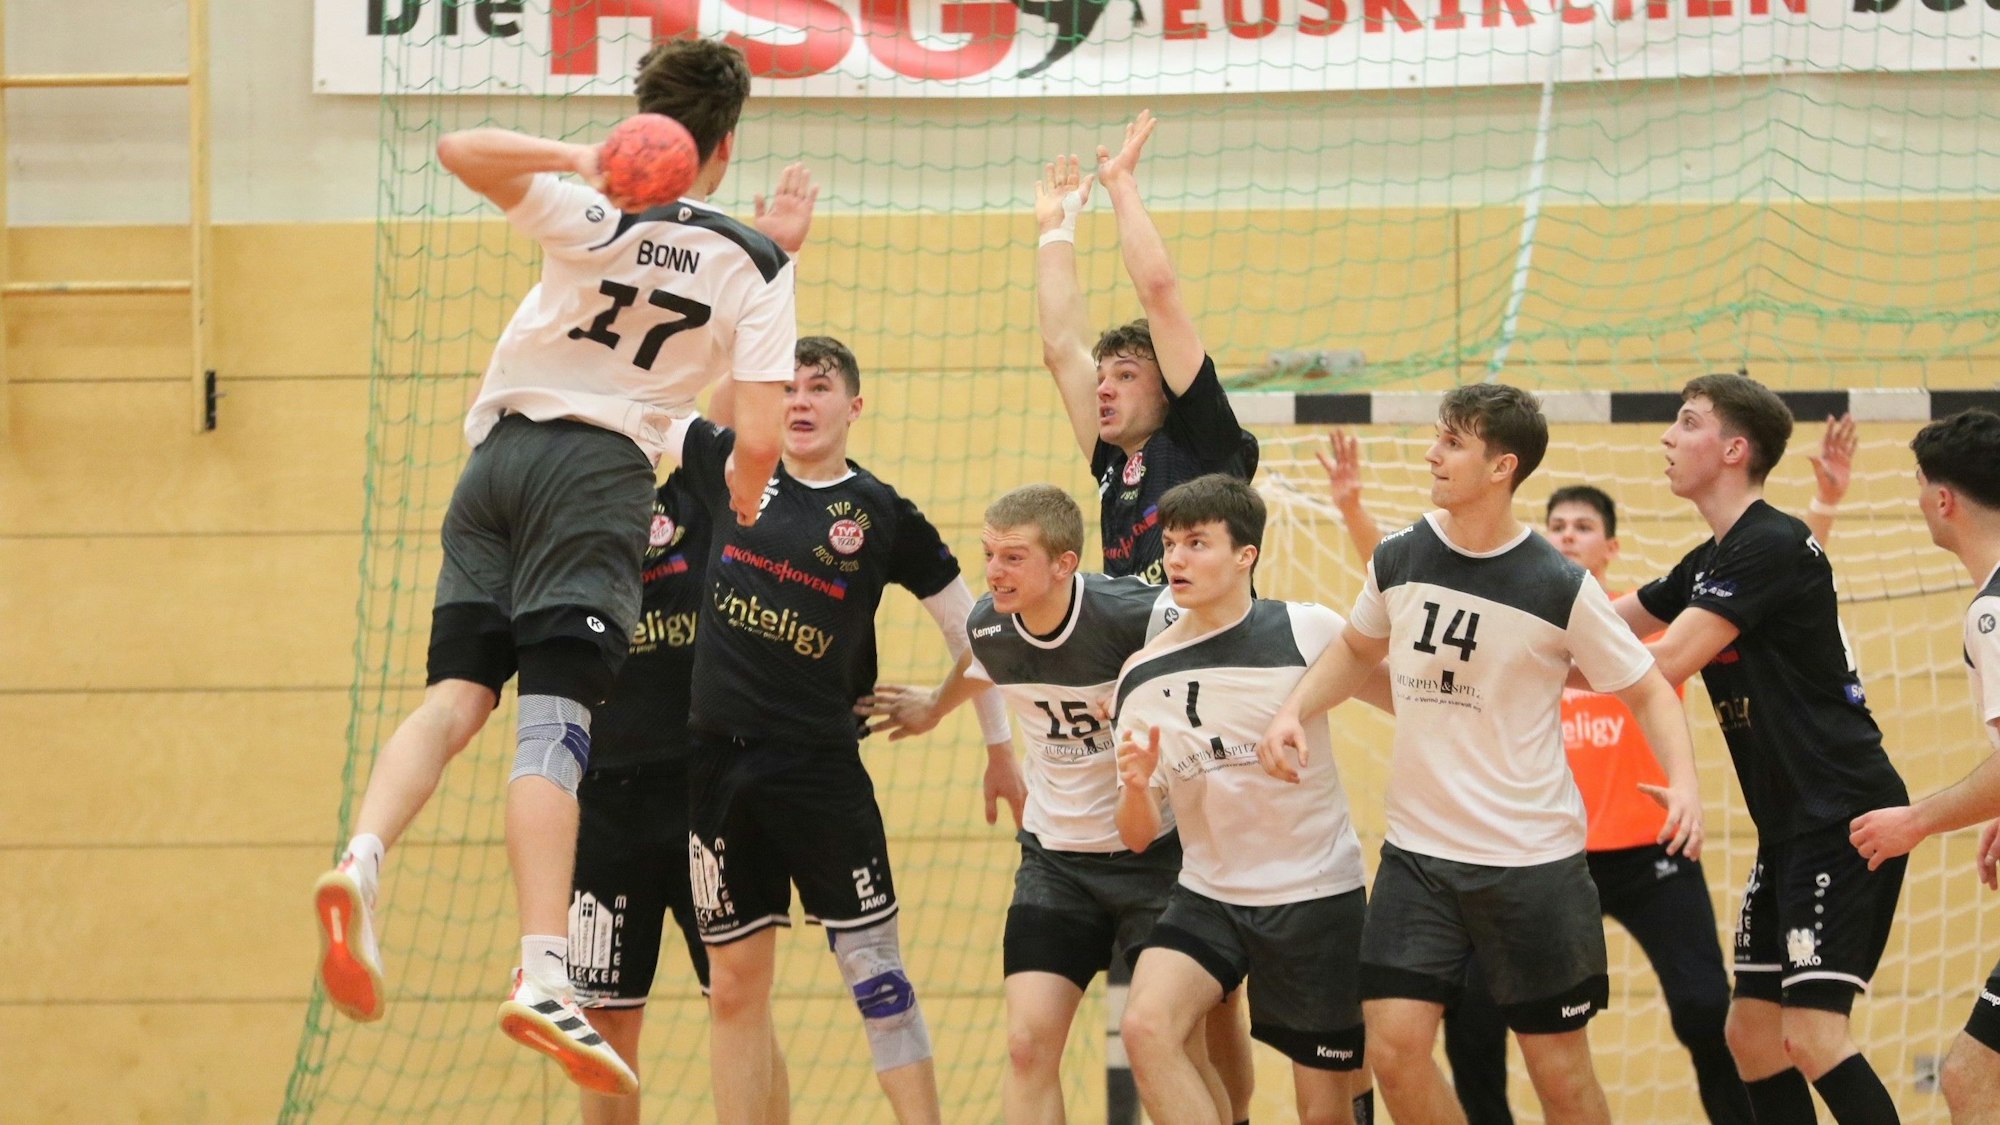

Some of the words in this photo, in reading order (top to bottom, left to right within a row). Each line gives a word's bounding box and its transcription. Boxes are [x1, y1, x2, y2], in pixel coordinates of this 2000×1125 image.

[637, 240, 700, 274] BONN
[568, 280, 711, 370] 17
[826, 502, 852, 517] TVP
[812, 545, 834, 566] 1920
[972, 624, 1001, 639] Kempa
[1413, 601, 1480, 661] 14
[1034, 701, 1101, 738] 15
[853, 867, 875, 898] 2
[860, 894, 887, 912] JAKO
[1560, 1000, 1592, 1018] Kempa
[1316, 1045, 1353, 1060] Kempa
